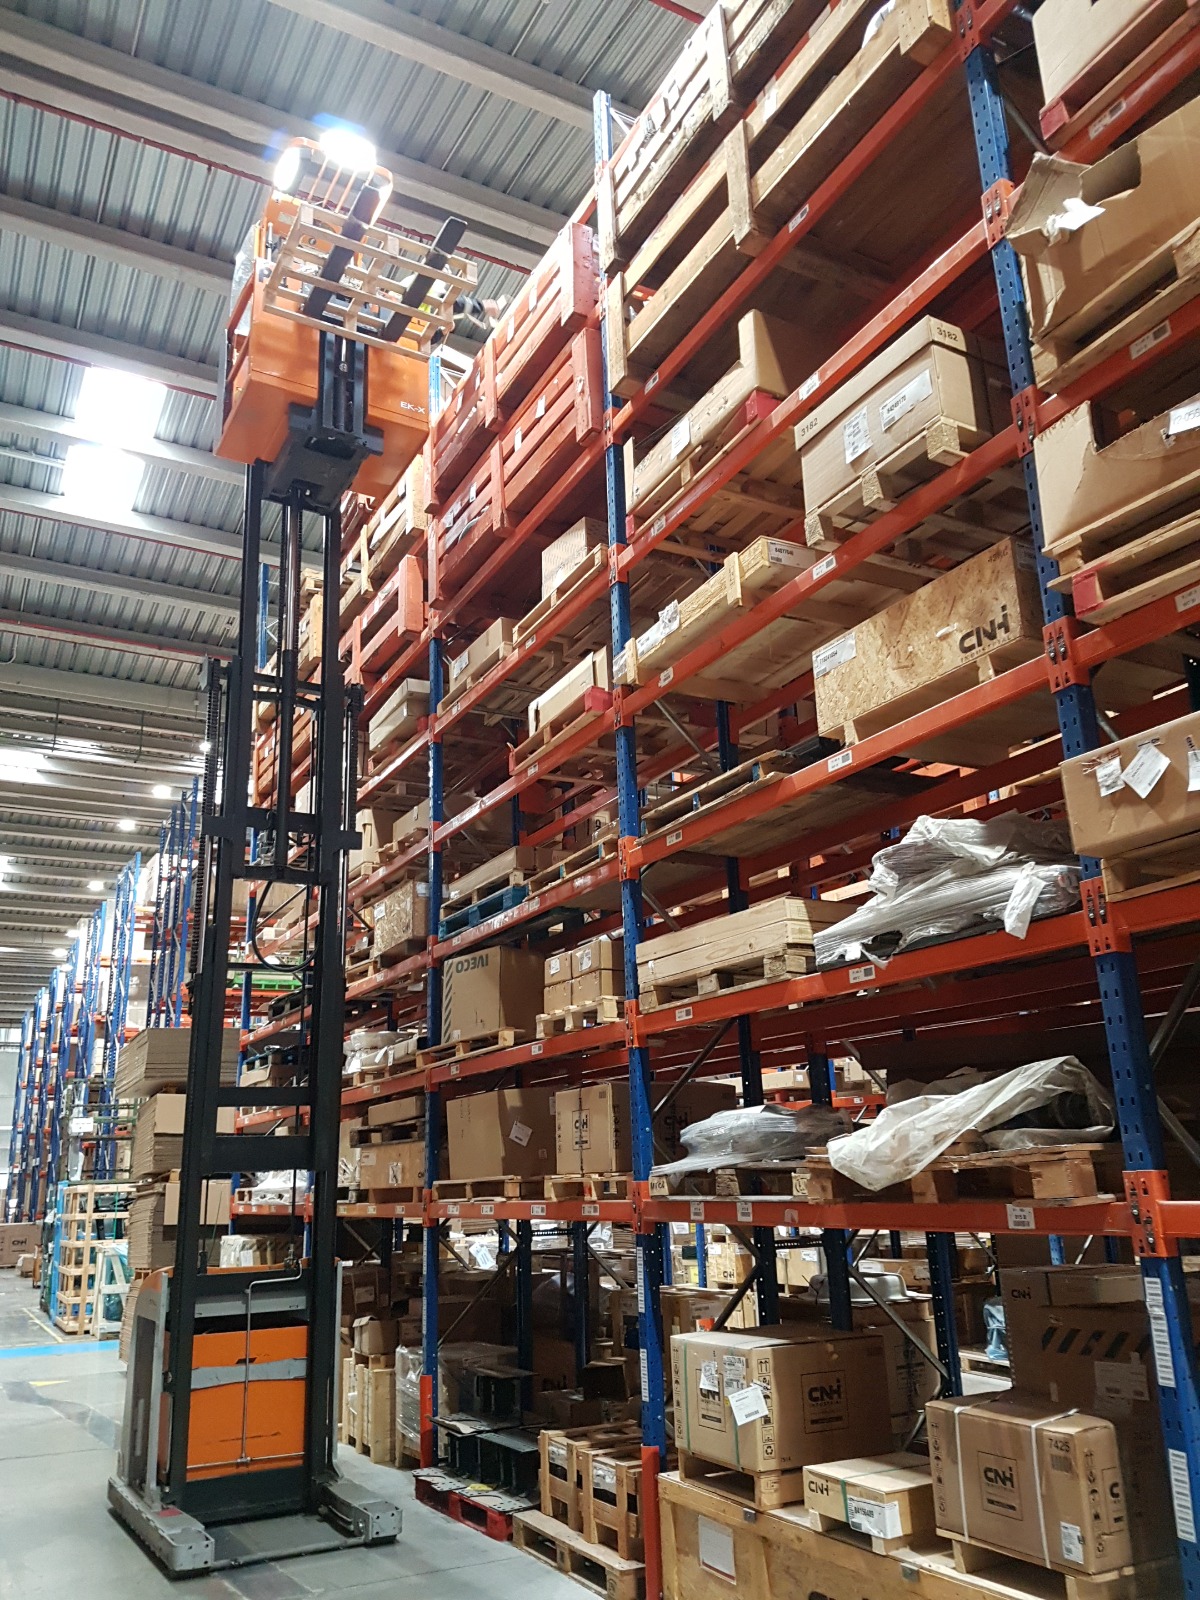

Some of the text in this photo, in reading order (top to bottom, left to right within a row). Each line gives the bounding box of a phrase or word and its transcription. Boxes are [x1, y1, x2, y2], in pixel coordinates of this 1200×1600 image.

[936, 326, 959, 342] 3182
[400, 401, 425, 414] EK-X
[801, 417, 818, 437] 3182
[456, 954, 489, 974] IVECO
[1048, 1438, 1071, 1453] 7425
